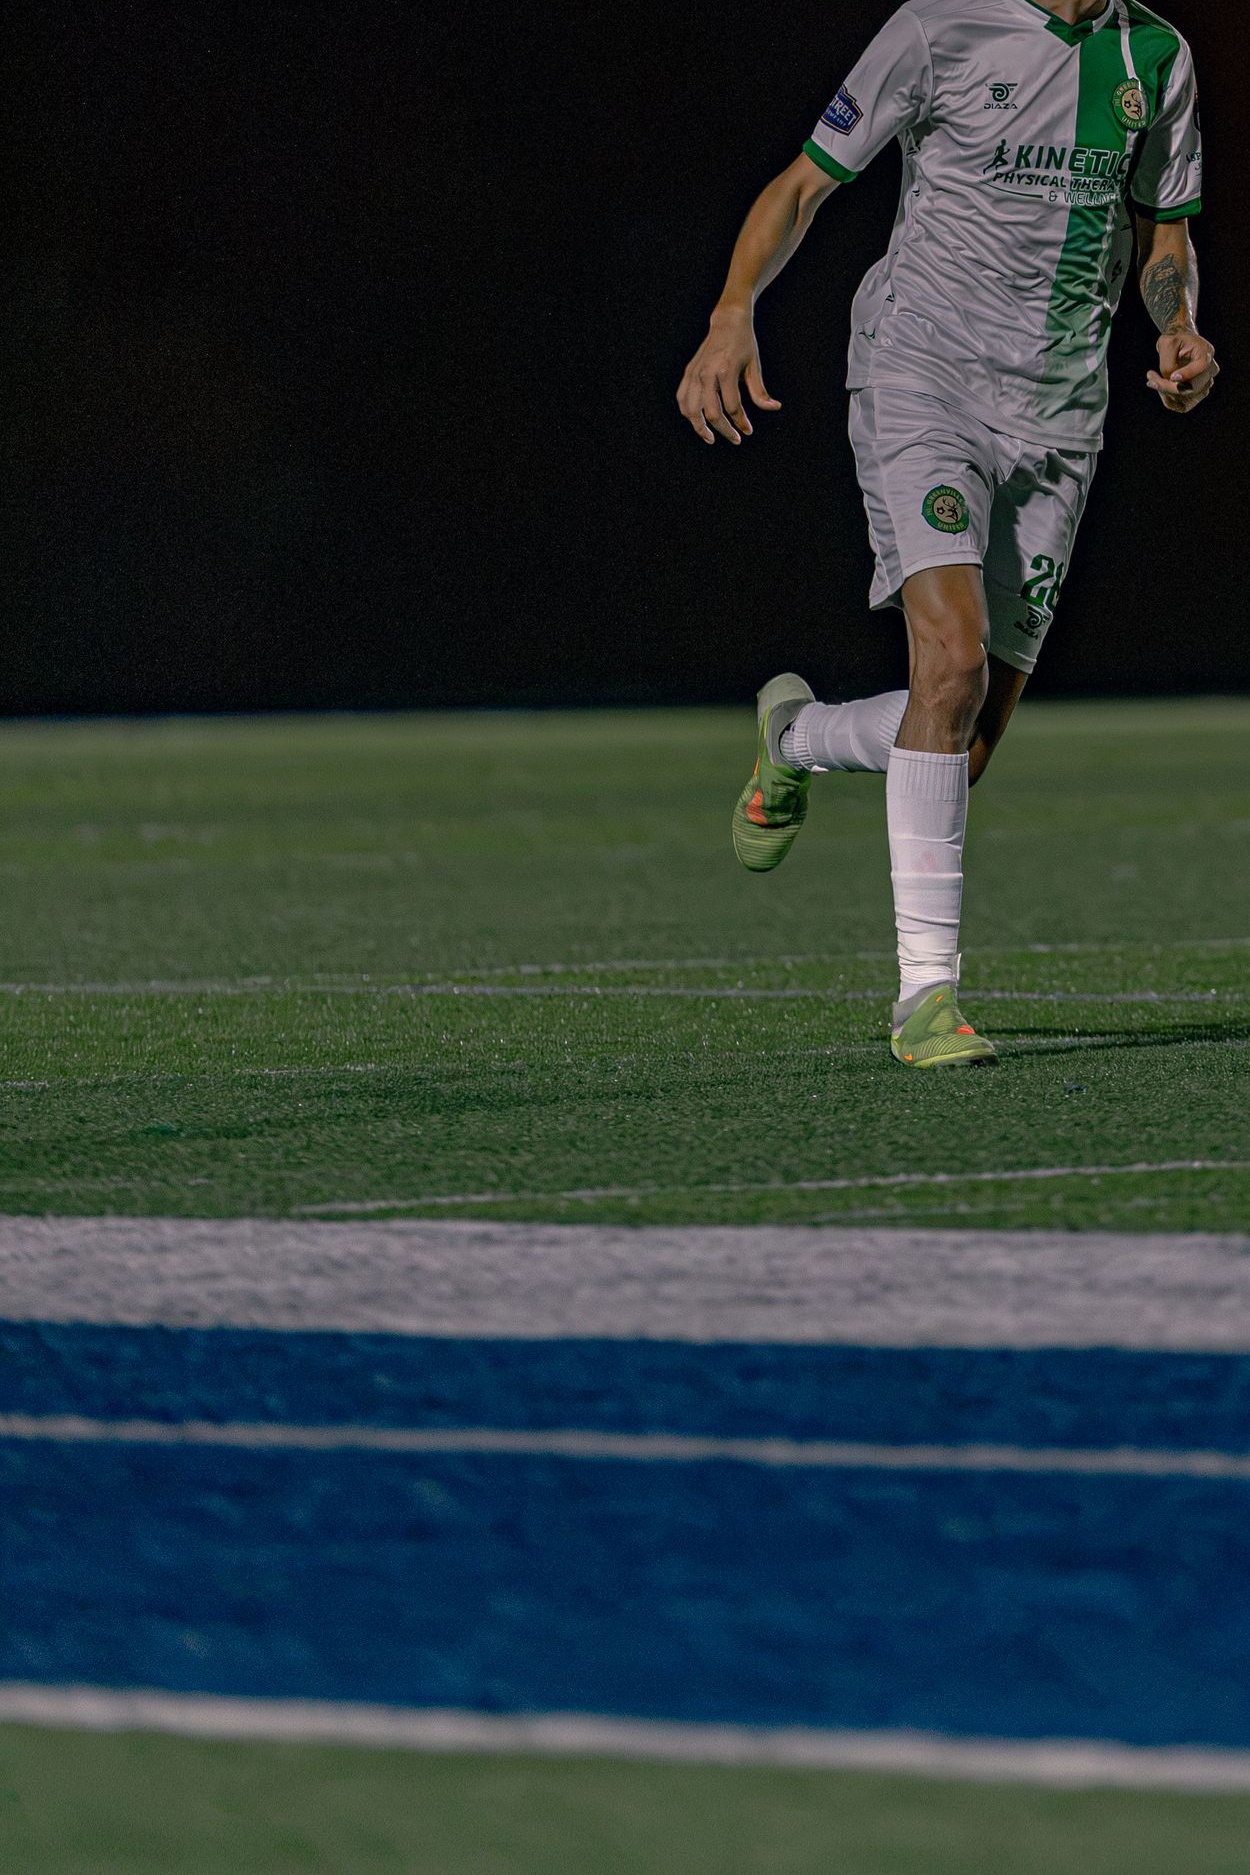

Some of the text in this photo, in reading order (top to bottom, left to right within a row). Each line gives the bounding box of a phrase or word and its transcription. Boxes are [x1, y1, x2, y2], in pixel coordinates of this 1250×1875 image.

[983, 102, 1018, 110] DIAZA
[1014, 144, 1132, 177] KINETIC
[992, 172, 1121, 193] PHYSICAL THERA
[1048, 190, 1059, 203] &
